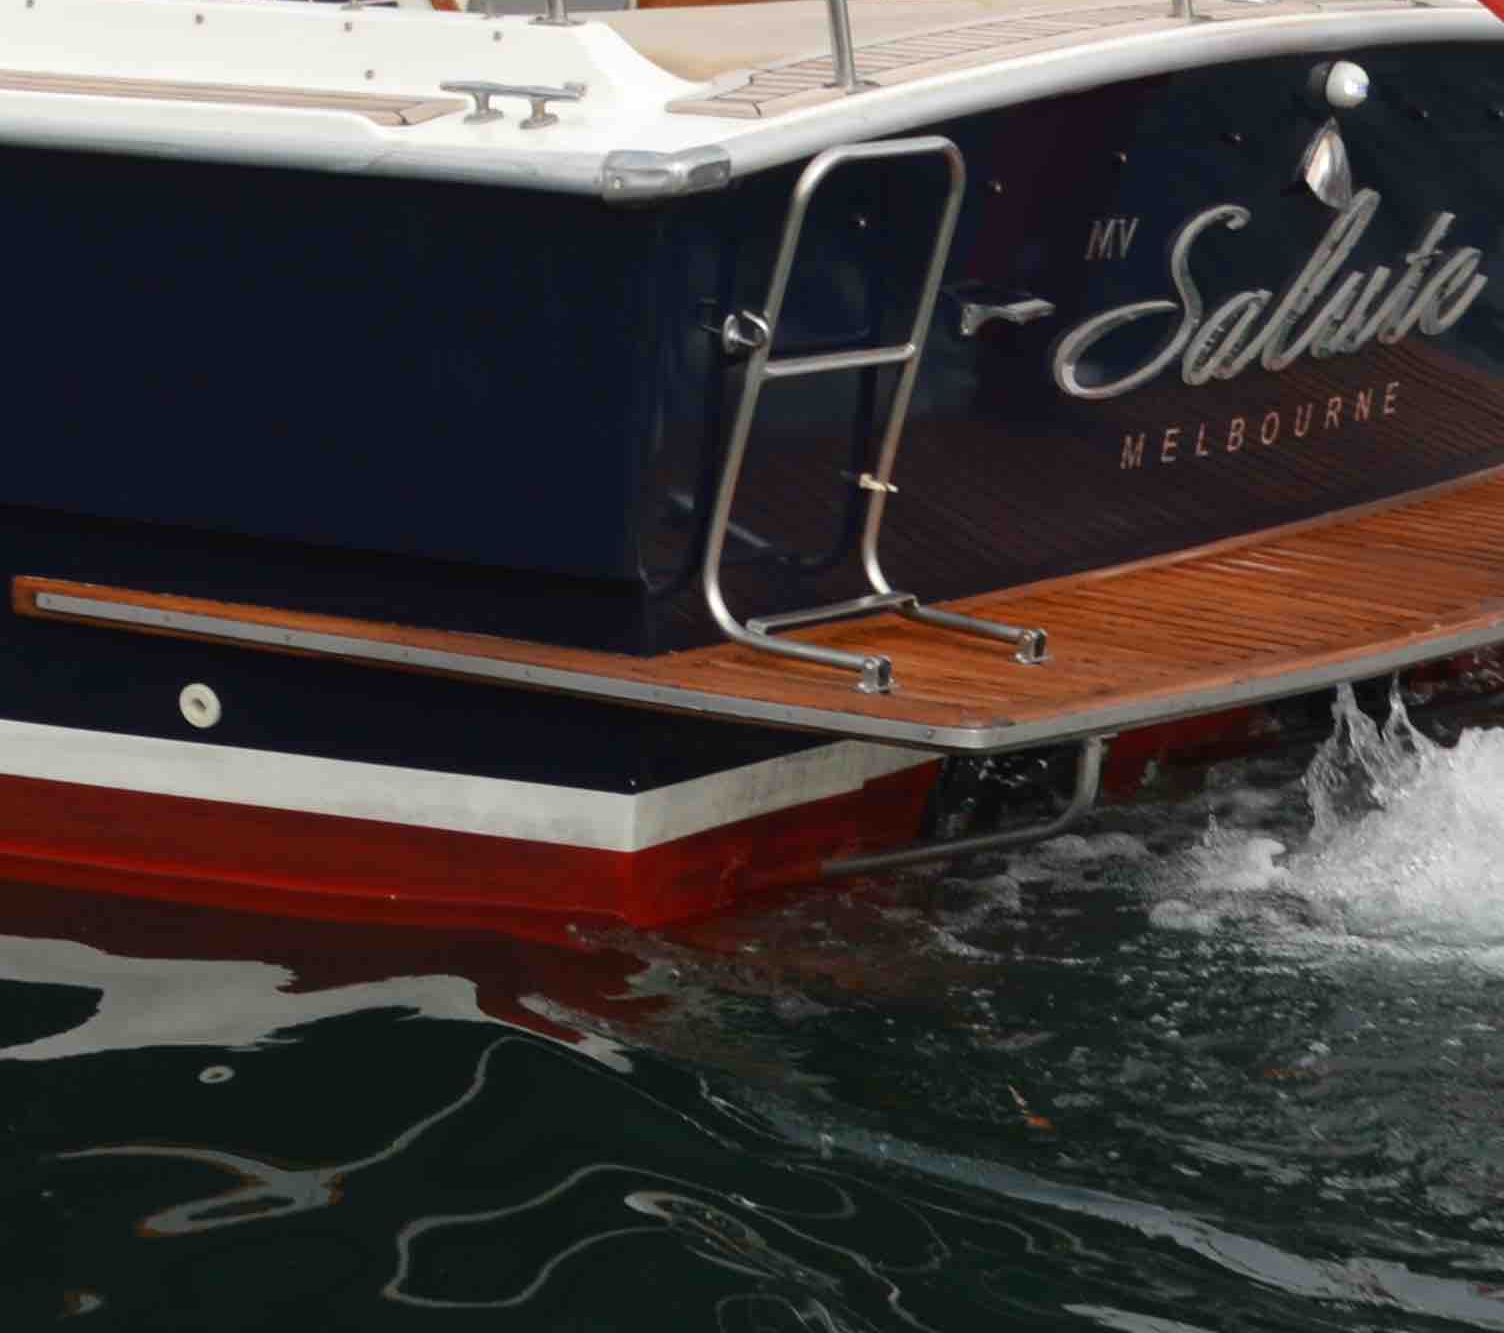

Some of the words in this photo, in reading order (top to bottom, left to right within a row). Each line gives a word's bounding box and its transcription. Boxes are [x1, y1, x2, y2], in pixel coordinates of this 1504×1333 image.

[1083, 216, 1140, 262] MV
[1052, 187, 1489, 400] Salute
[1119, 380, 1401, 471] MELBOURNE
